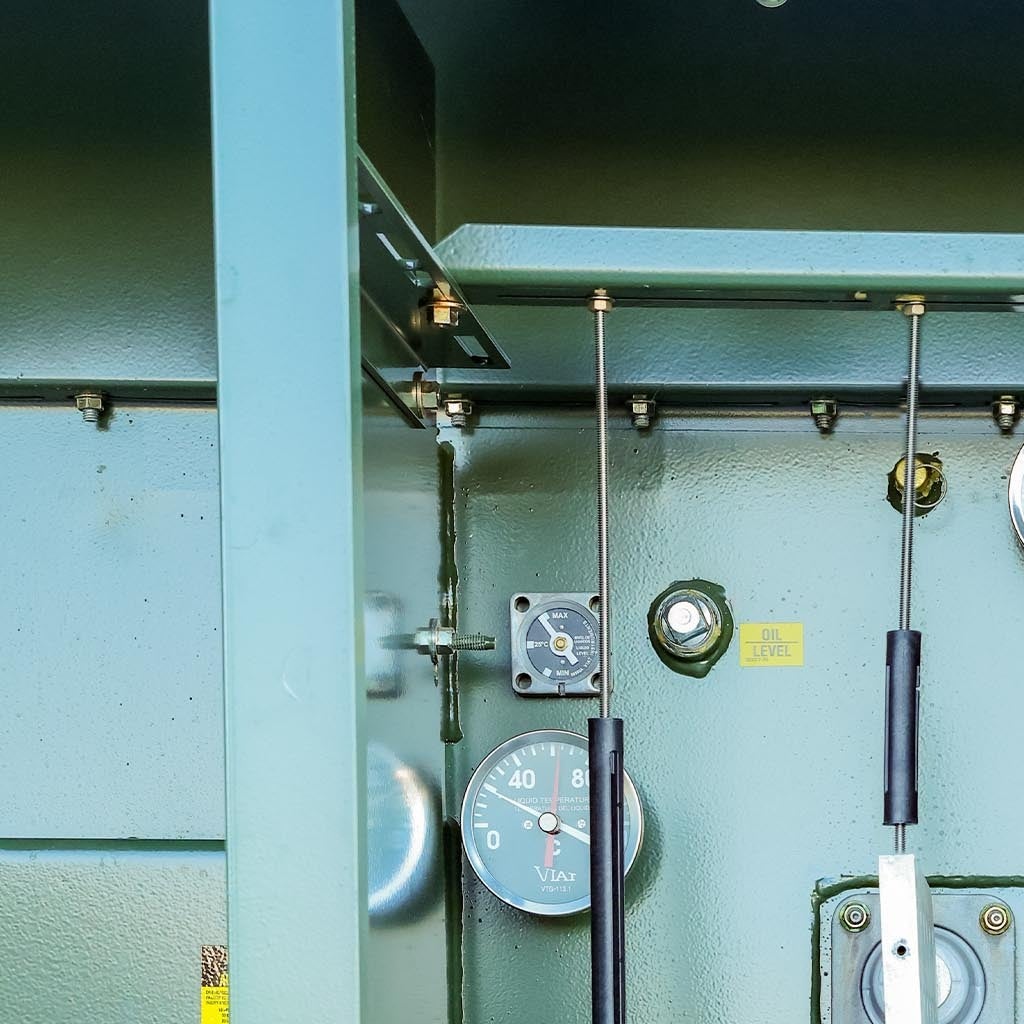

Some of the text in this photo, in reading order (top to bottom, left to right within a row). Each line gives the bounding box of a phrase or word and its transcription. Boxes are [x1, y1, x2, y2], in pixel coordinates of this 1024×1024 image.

[762, 628, 782, 641] OIL
[753, 644, 792, 657] LEVEL
[508, 769, 536, 789] 40
[486, 830, 501, 850] 0
